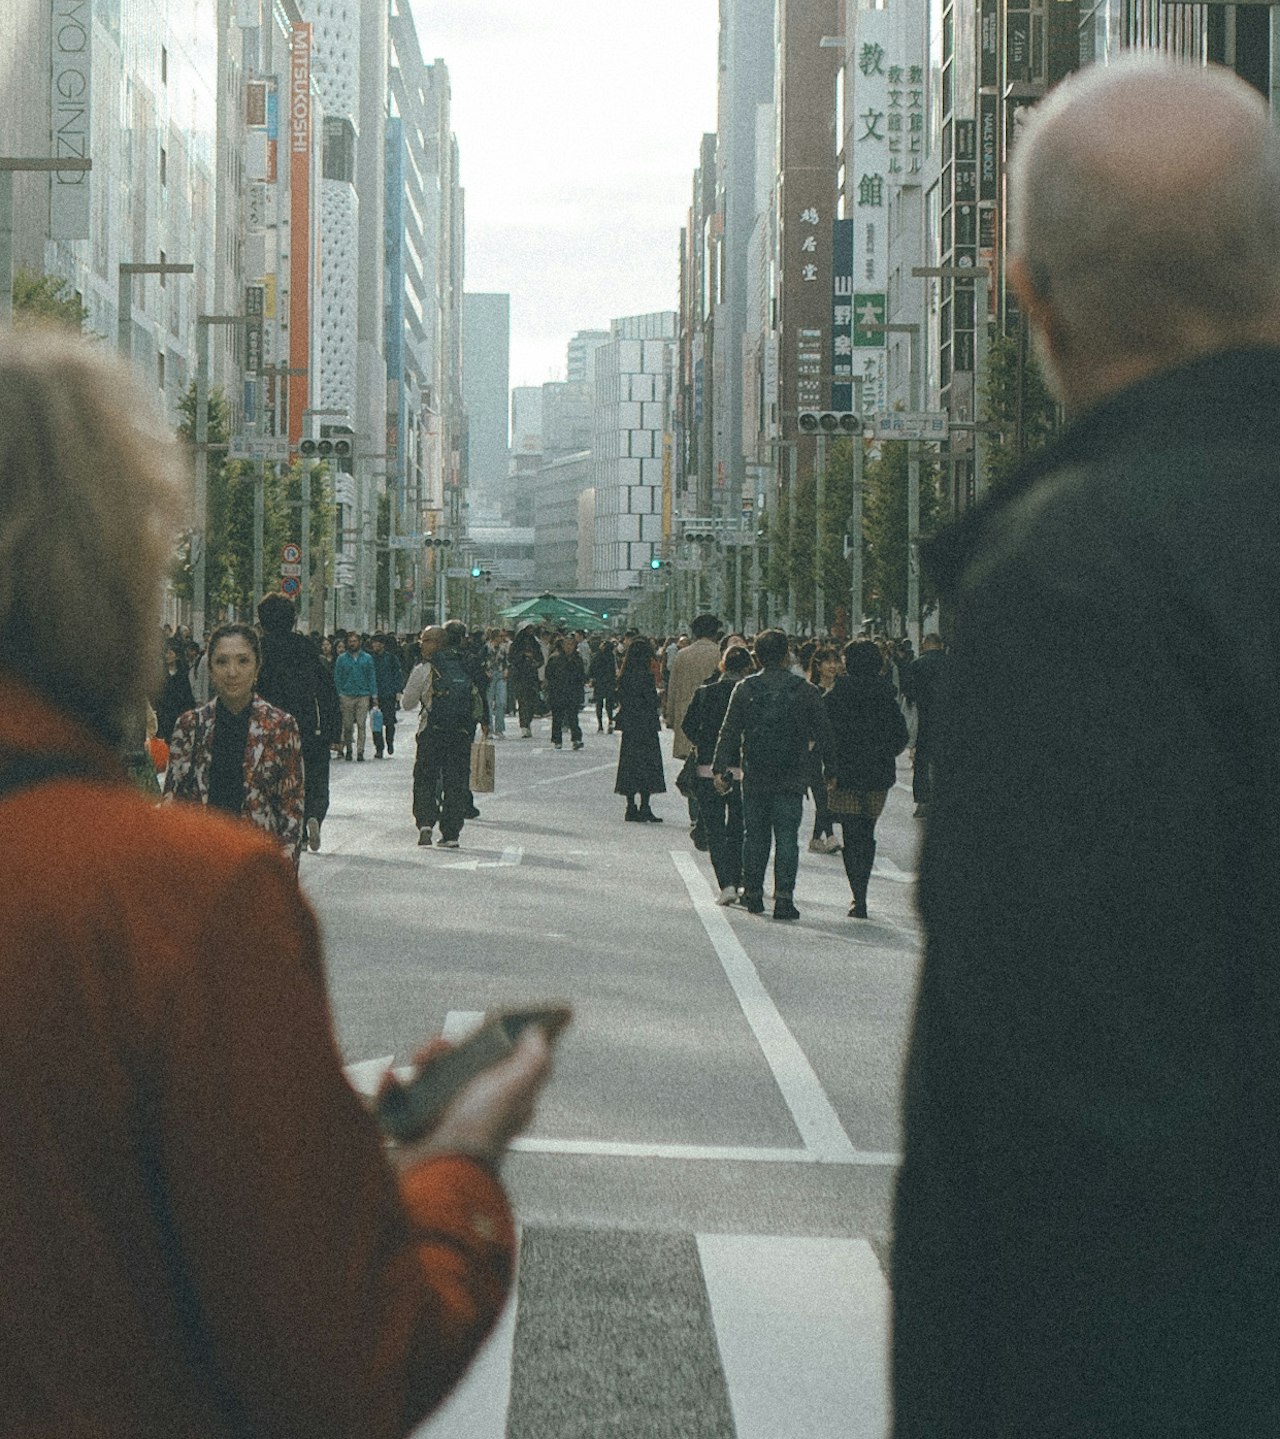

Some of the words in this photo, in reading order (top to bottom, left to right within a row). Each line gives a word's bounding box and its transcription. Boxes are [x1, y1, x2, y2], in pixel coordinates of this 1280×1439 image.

[293, 30, 308, 153] MITSUKOSHI
[857, 42, 885, 207] 教文館
[887, 65, 904, 174] 教文館ビル
[908, 65, 923, 174] 教文館ビル
[984, 112, 993, 142] NAILS
[984, 143, 993, 182] UNIQUE
